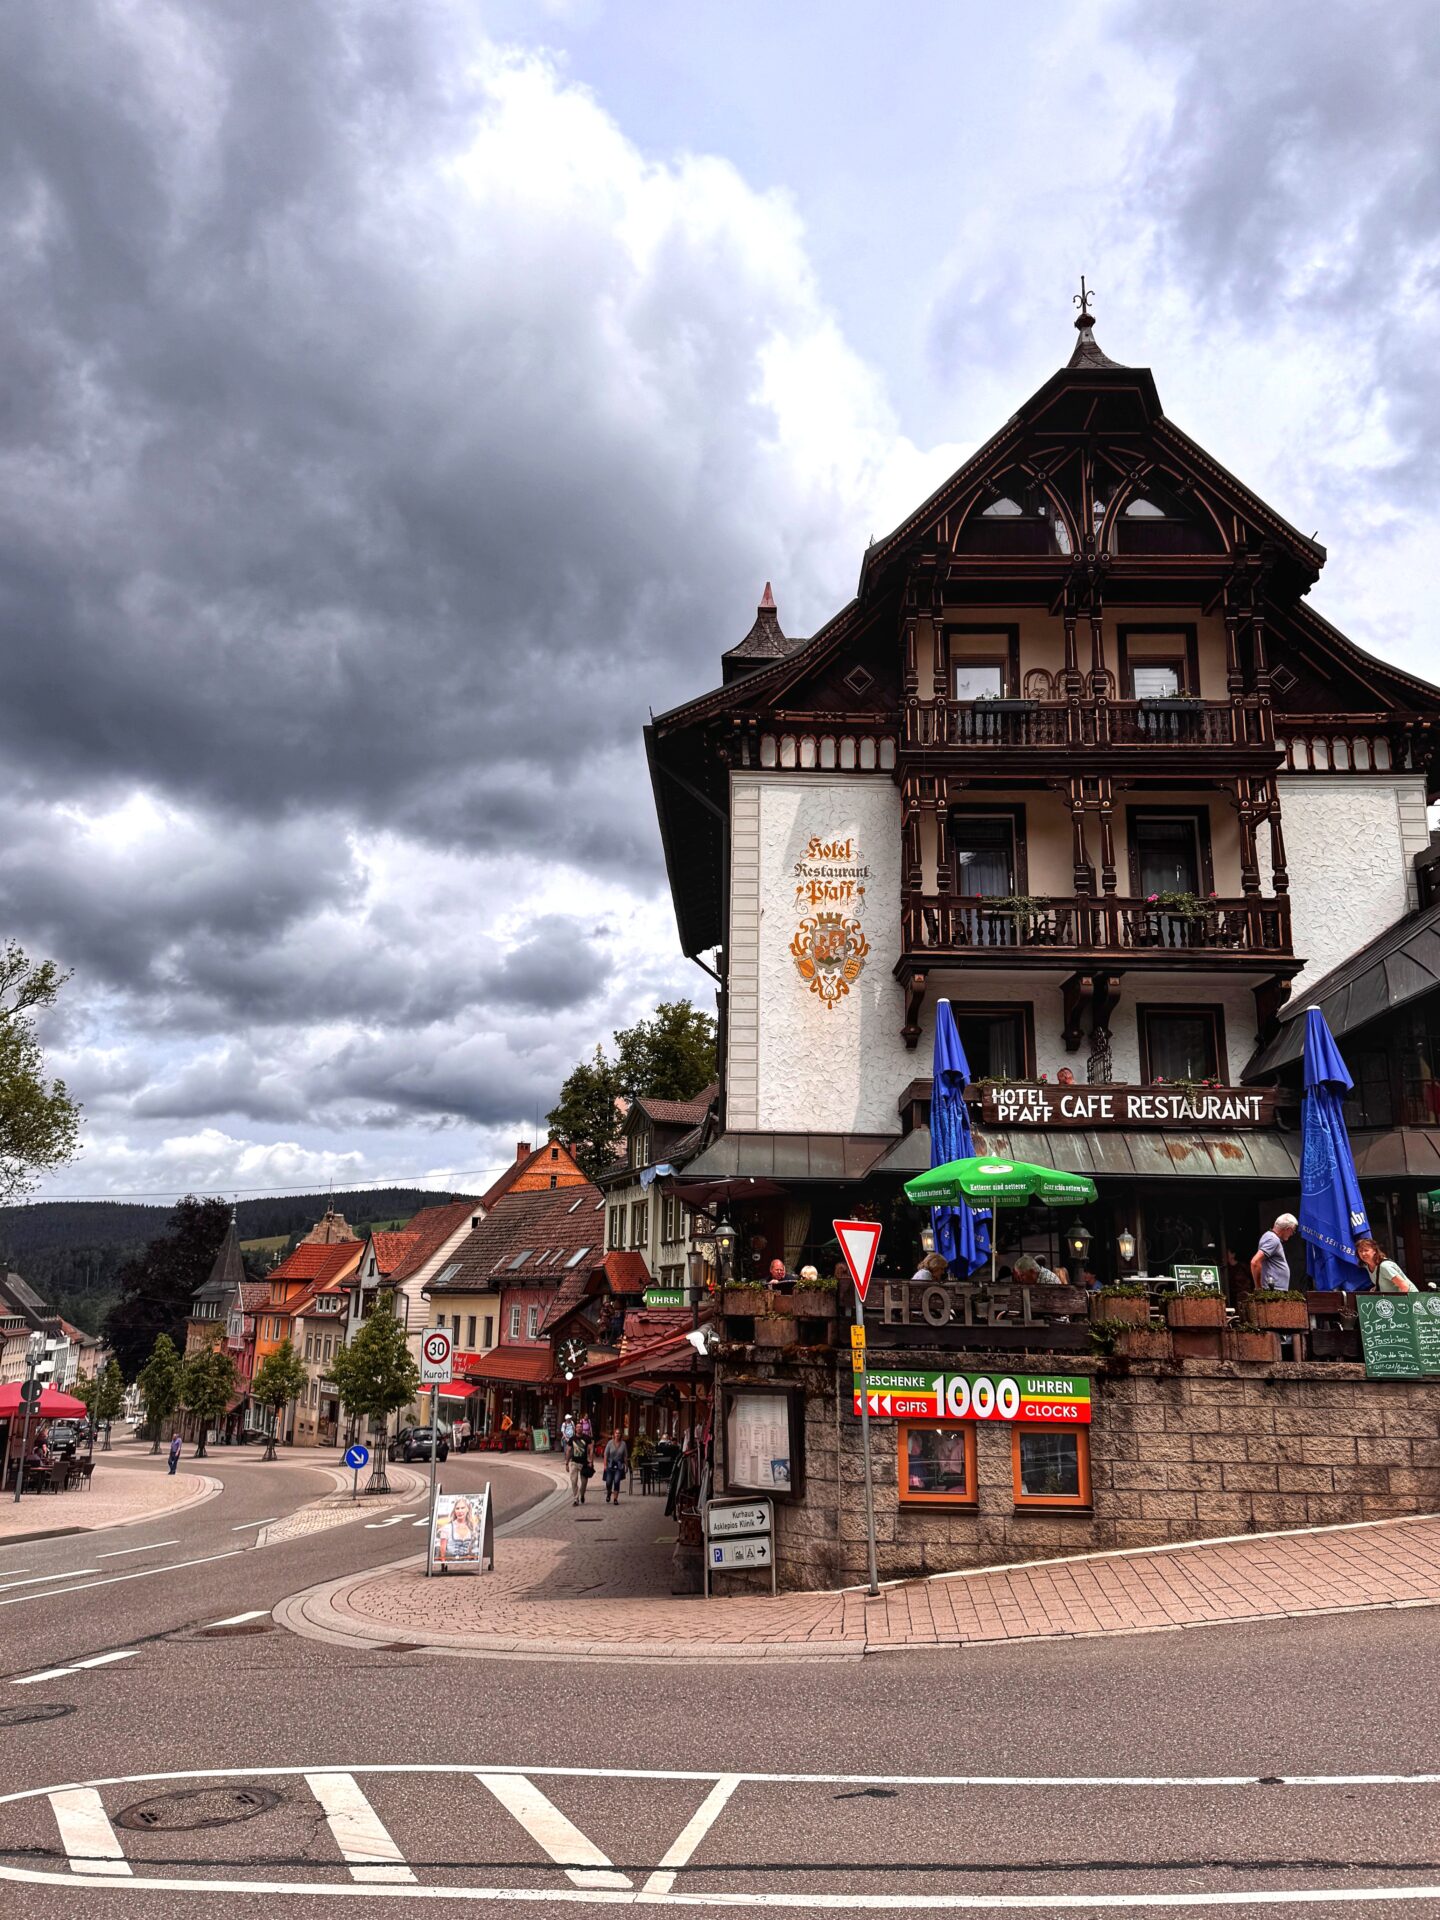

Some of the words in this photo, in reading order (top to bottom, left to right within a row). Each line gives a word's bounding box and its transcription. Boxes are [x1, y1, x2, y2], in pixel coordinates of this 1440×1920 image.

[808, 837, 855, 859] Hotel
[794, 863, 870, 878] Restaurant
[805, 880, 857, 905] Pfaff
[992, 1088, 1048, 1106] HOTEL
[998, 1105, 1053, 1122] PFAFF
[1060, 1095, 1114, 1118] CAFE
[1128, 1095, 1263, 1121] RESTAURANT
[650, 1296, 680, 1304] UHREN
[884, 1285, 1045, 1327] HOTEL
[429, 1341, 445, 1356] 30
[424, 1370, 449, 1379] Kurort
[1027, 1379, 1073, 1394] UHREN
[931, 1374, 1020, 1419] 1000
[896, 1401, 928, 1413] GIFTS
[1025, 1405, 1078, 1418] CLOCKS
[732, 1510, 755, 1519] Kurhaus
[713, 1522, 738, 1531] Asklepios
[739, 1519, 755, 1528] Klinik
